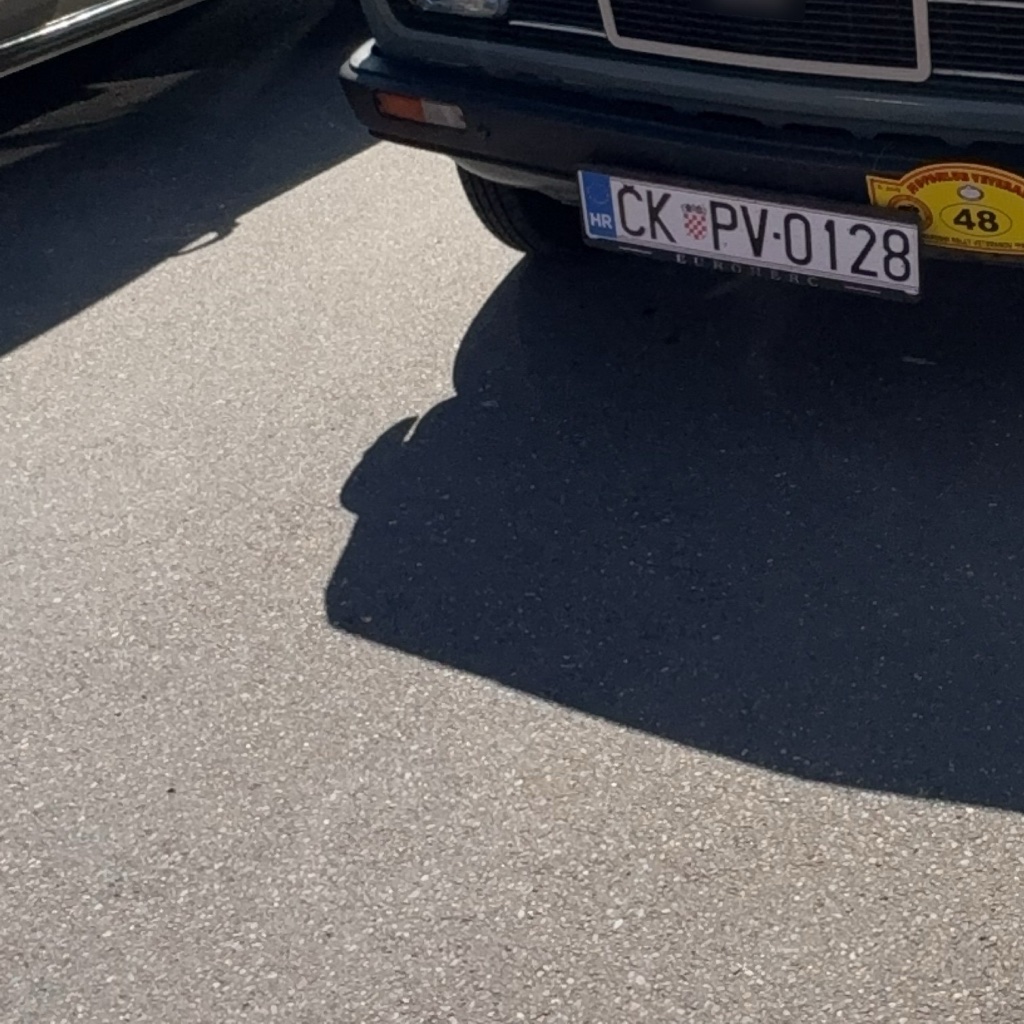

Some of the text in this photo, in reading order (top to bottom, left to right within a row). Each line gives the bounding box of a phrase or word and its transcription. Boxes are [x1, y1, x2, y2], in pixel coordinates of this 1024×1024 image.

[589, 212, 613, 230] HR
[616, 184, 677, 244] ČK
[953, 208, 999, 233] 48
